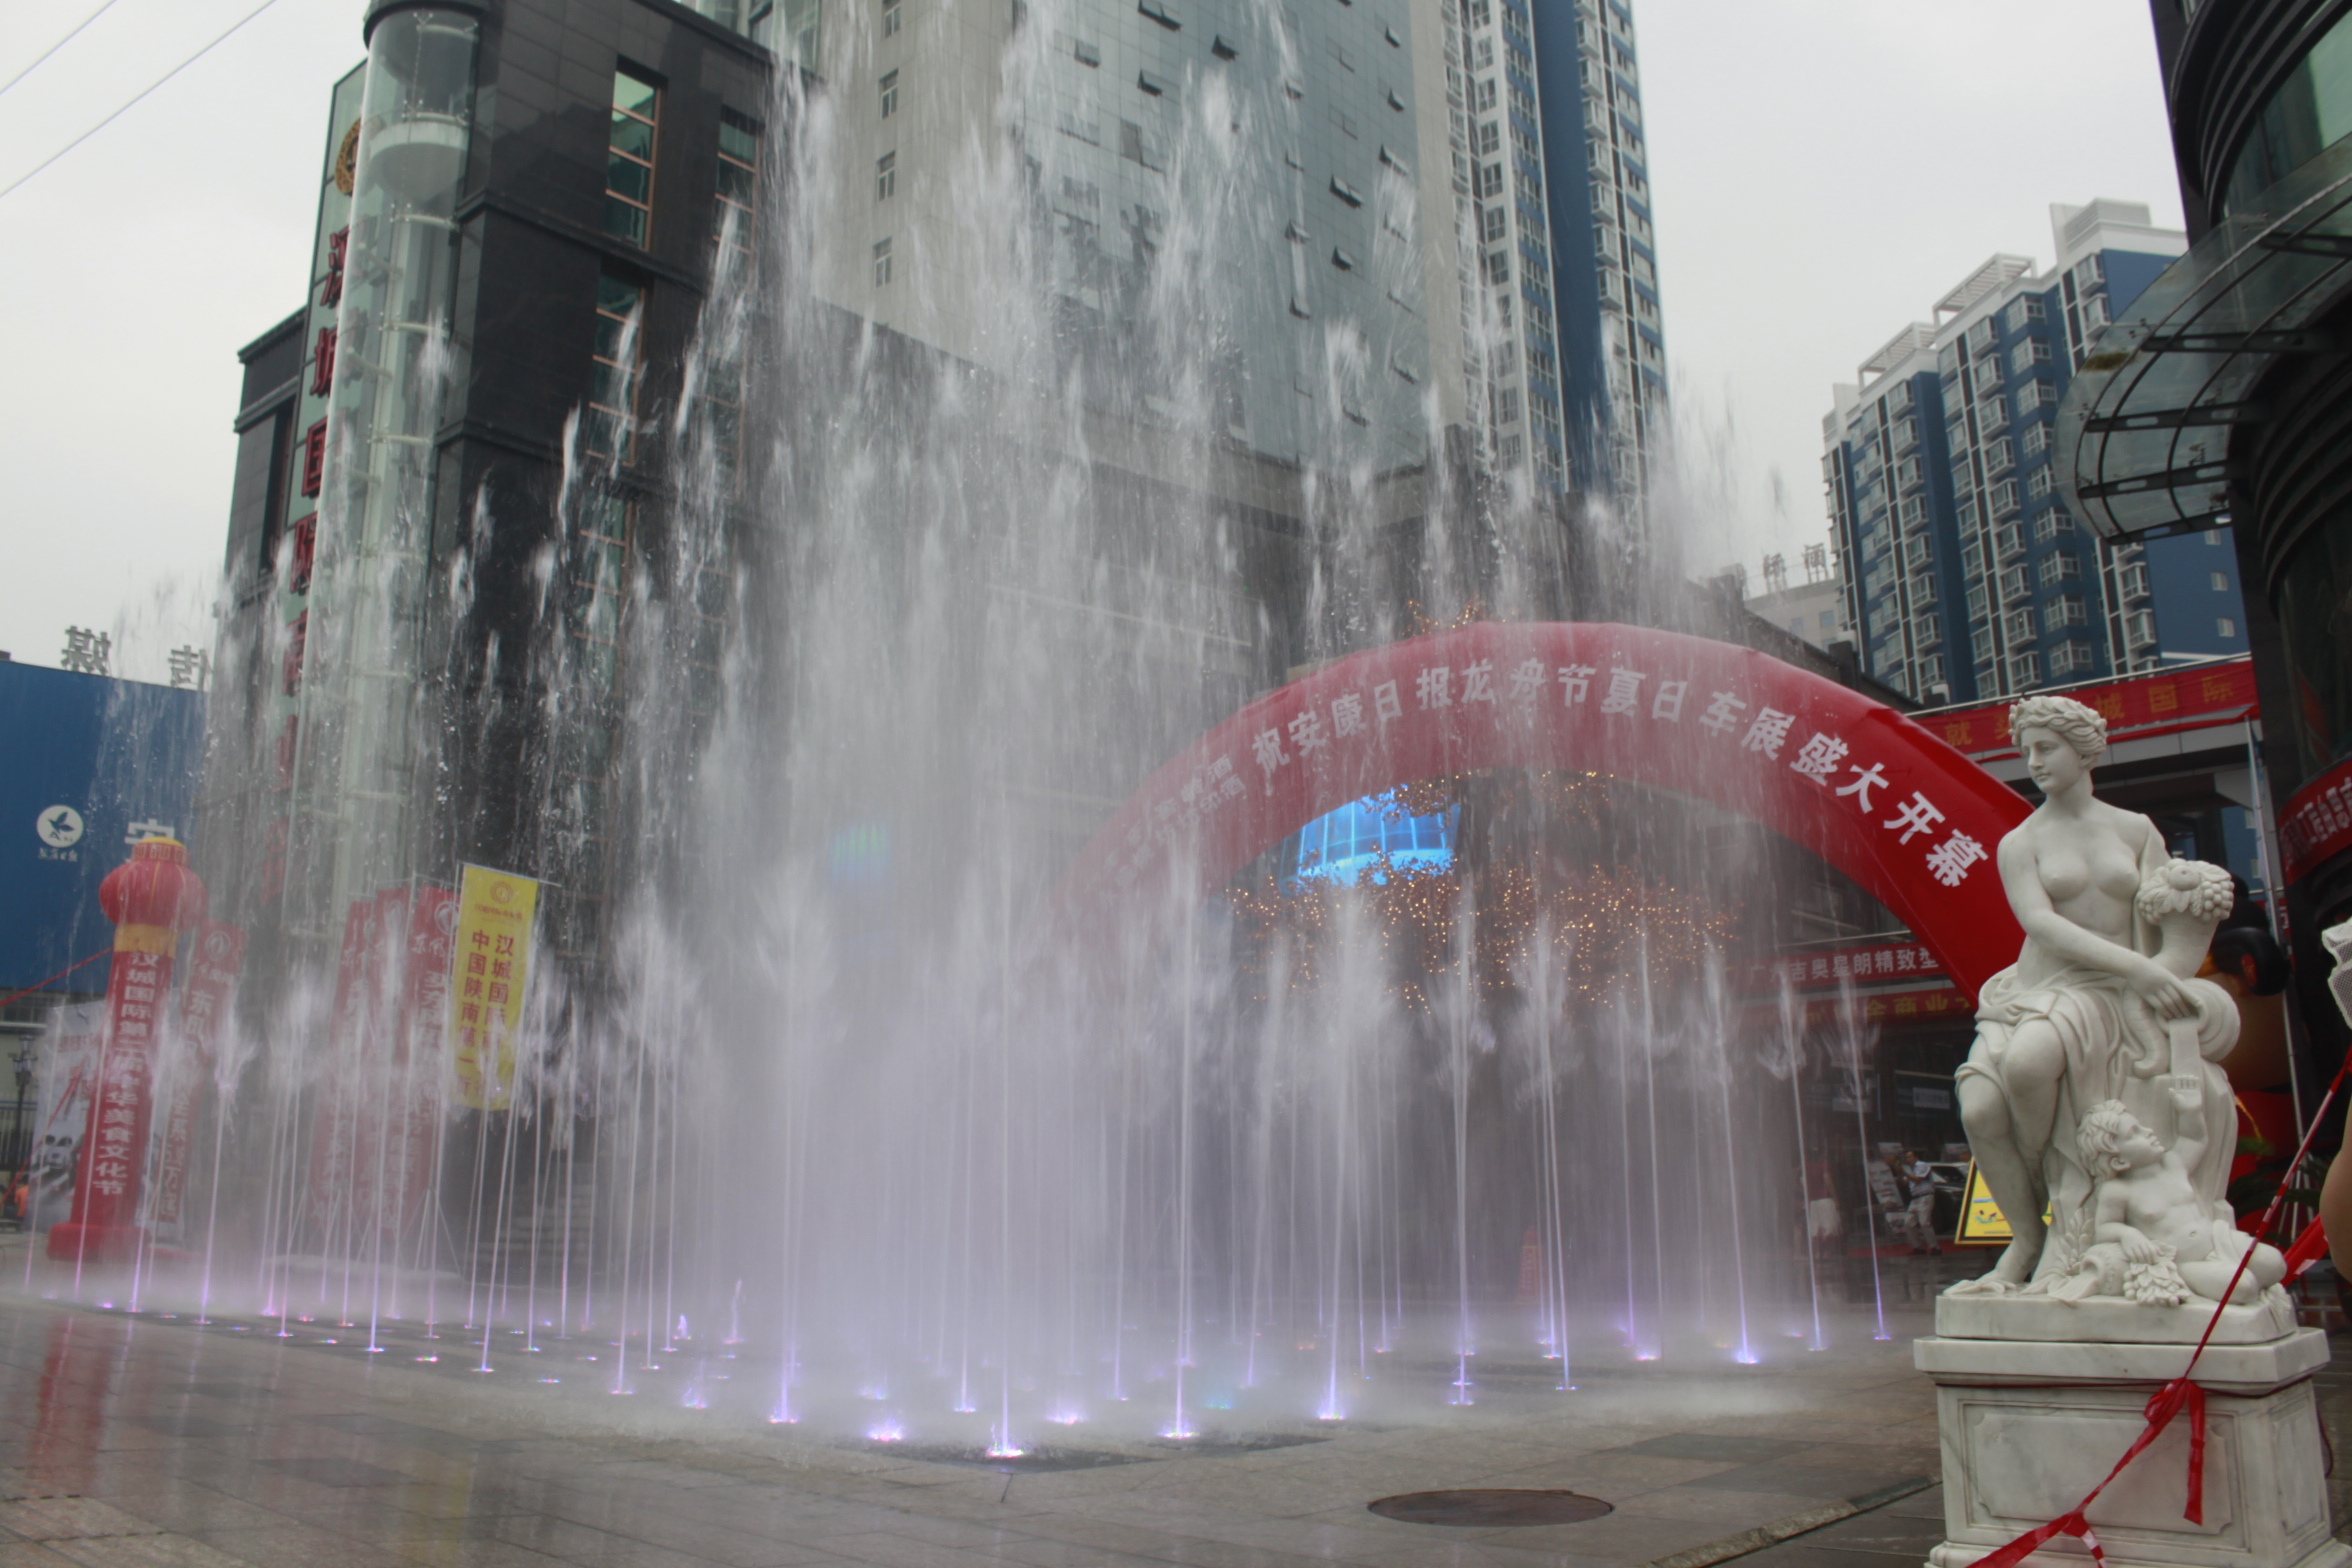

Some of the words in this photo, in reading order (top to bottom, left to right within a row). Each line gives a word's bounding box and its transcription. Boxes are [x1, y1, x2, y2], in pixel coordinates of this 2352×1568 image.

[1251, 656, 1989, 888] 祝安康日报龙舟节夏日车展盛大开幕
